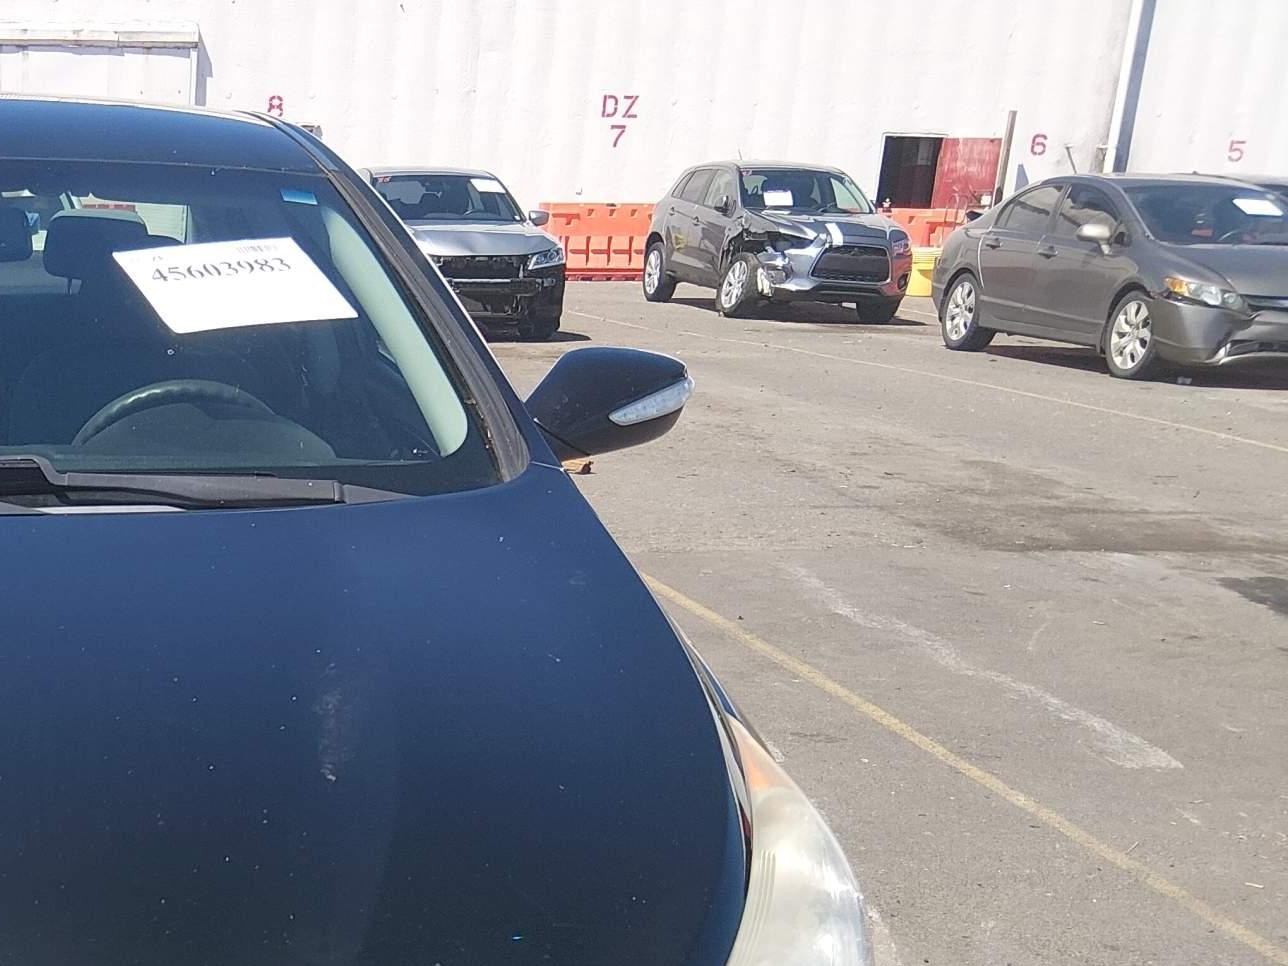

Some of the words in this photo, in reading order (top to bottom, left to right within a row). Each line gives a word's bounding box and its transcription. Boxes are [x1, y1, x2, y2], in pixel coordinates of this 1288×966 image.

[267, 95, 284, 117] 8
[601, 94, 640, 118] DZ
[610, 124, 626, 148] 7
[1030, 133, 1048, 156] 6
[1227, 139, 1247, 162] 5
[151, 257, 292, 283] 45603983
